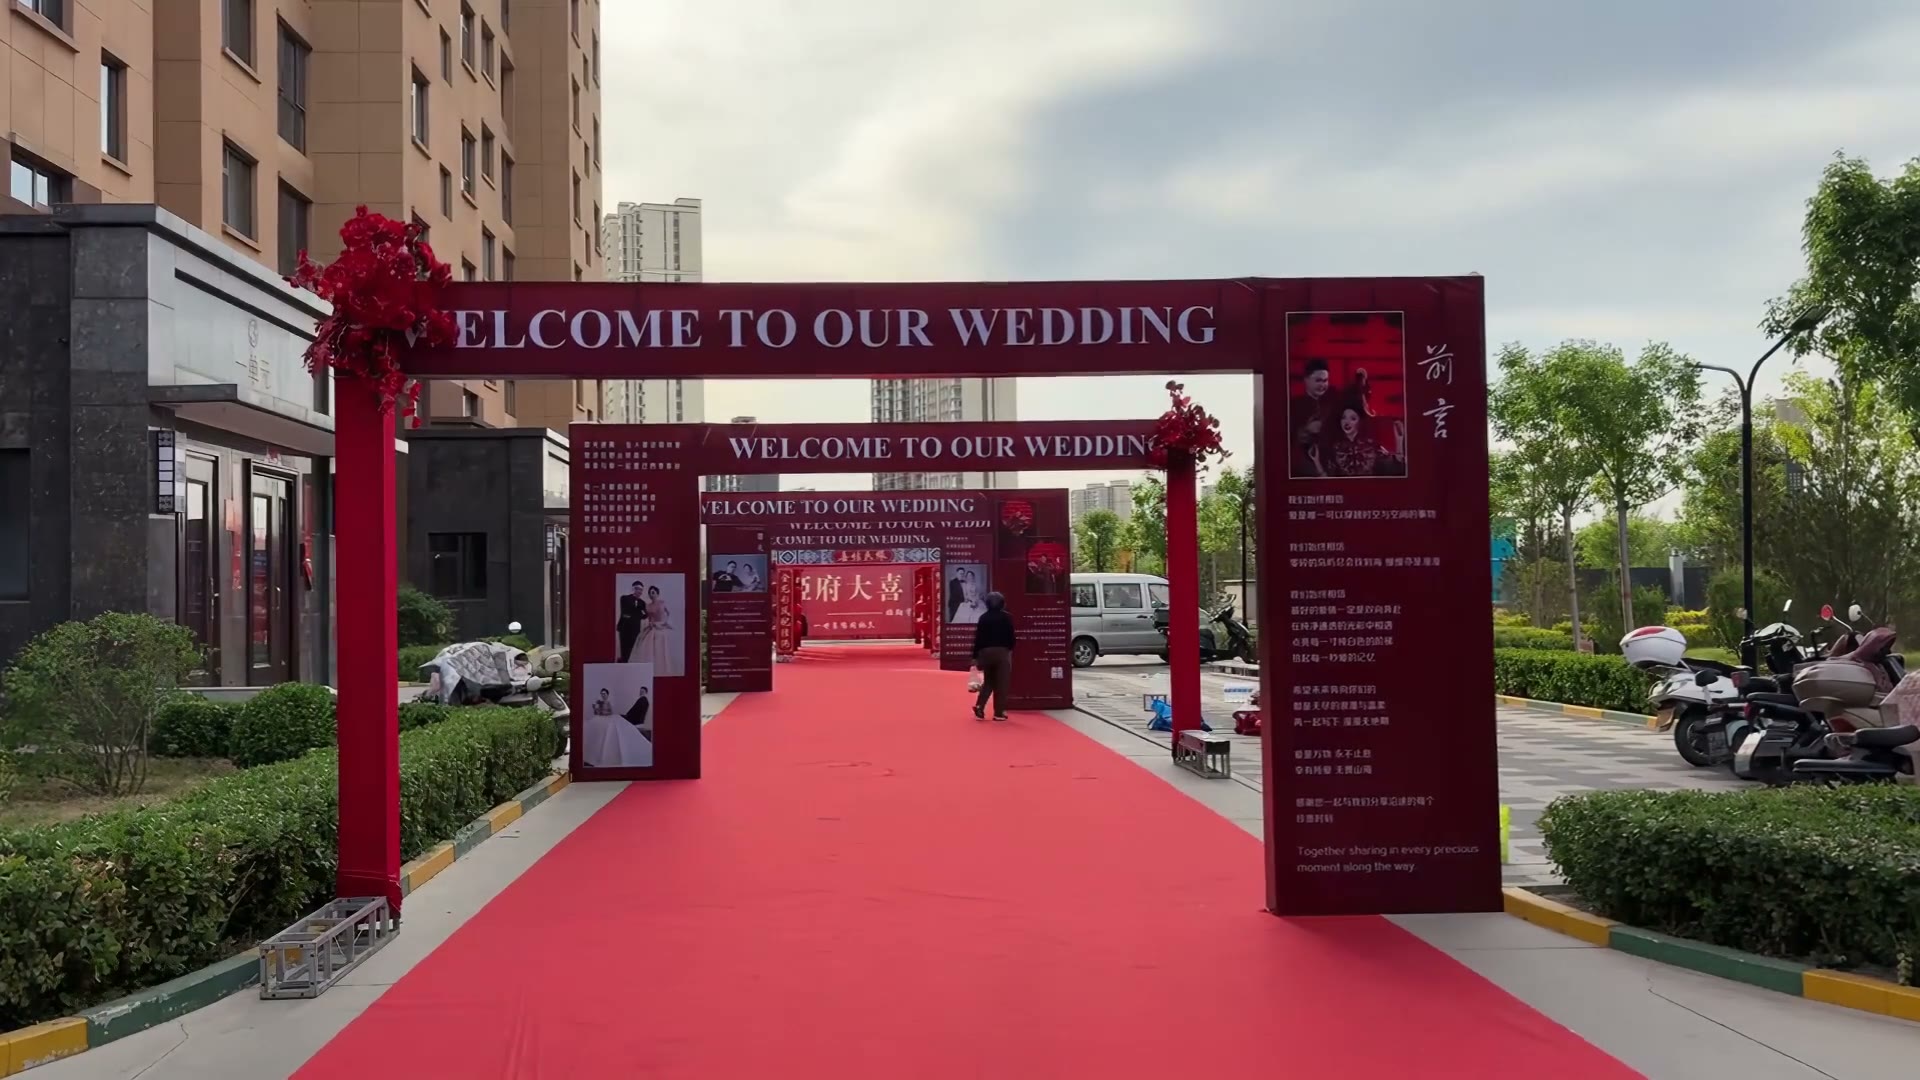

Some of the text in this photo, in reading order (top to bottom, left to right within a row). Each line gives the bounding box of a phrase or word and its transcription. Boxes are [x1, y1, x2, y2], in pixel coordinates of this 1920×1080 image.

[441, 306, 1217, 349] ELCOME TO OUR WEDDING
[1417, 343, 1455, 438] 前言
[729, 437, 892, 459] WELCOME
[900, 436, 942, 459] TO
[951, 436, 1015, 458] OUR
[801, 500, 829, 514] TO
[834, 499, 876, 514] OUR
[881, 498, 974, 513] WEDDING
[818, 535, 836, 545] TO
[839, 535, 866, 545] OUR
[869, 534, 930, 544] WEDDING
[1298, 845, 1479, 857] Together sharing in every precious
[1297, 863, 1340, 872] moment
[1344, 862, 1372, 873] along
[1374, 862, 1391, 871] the
